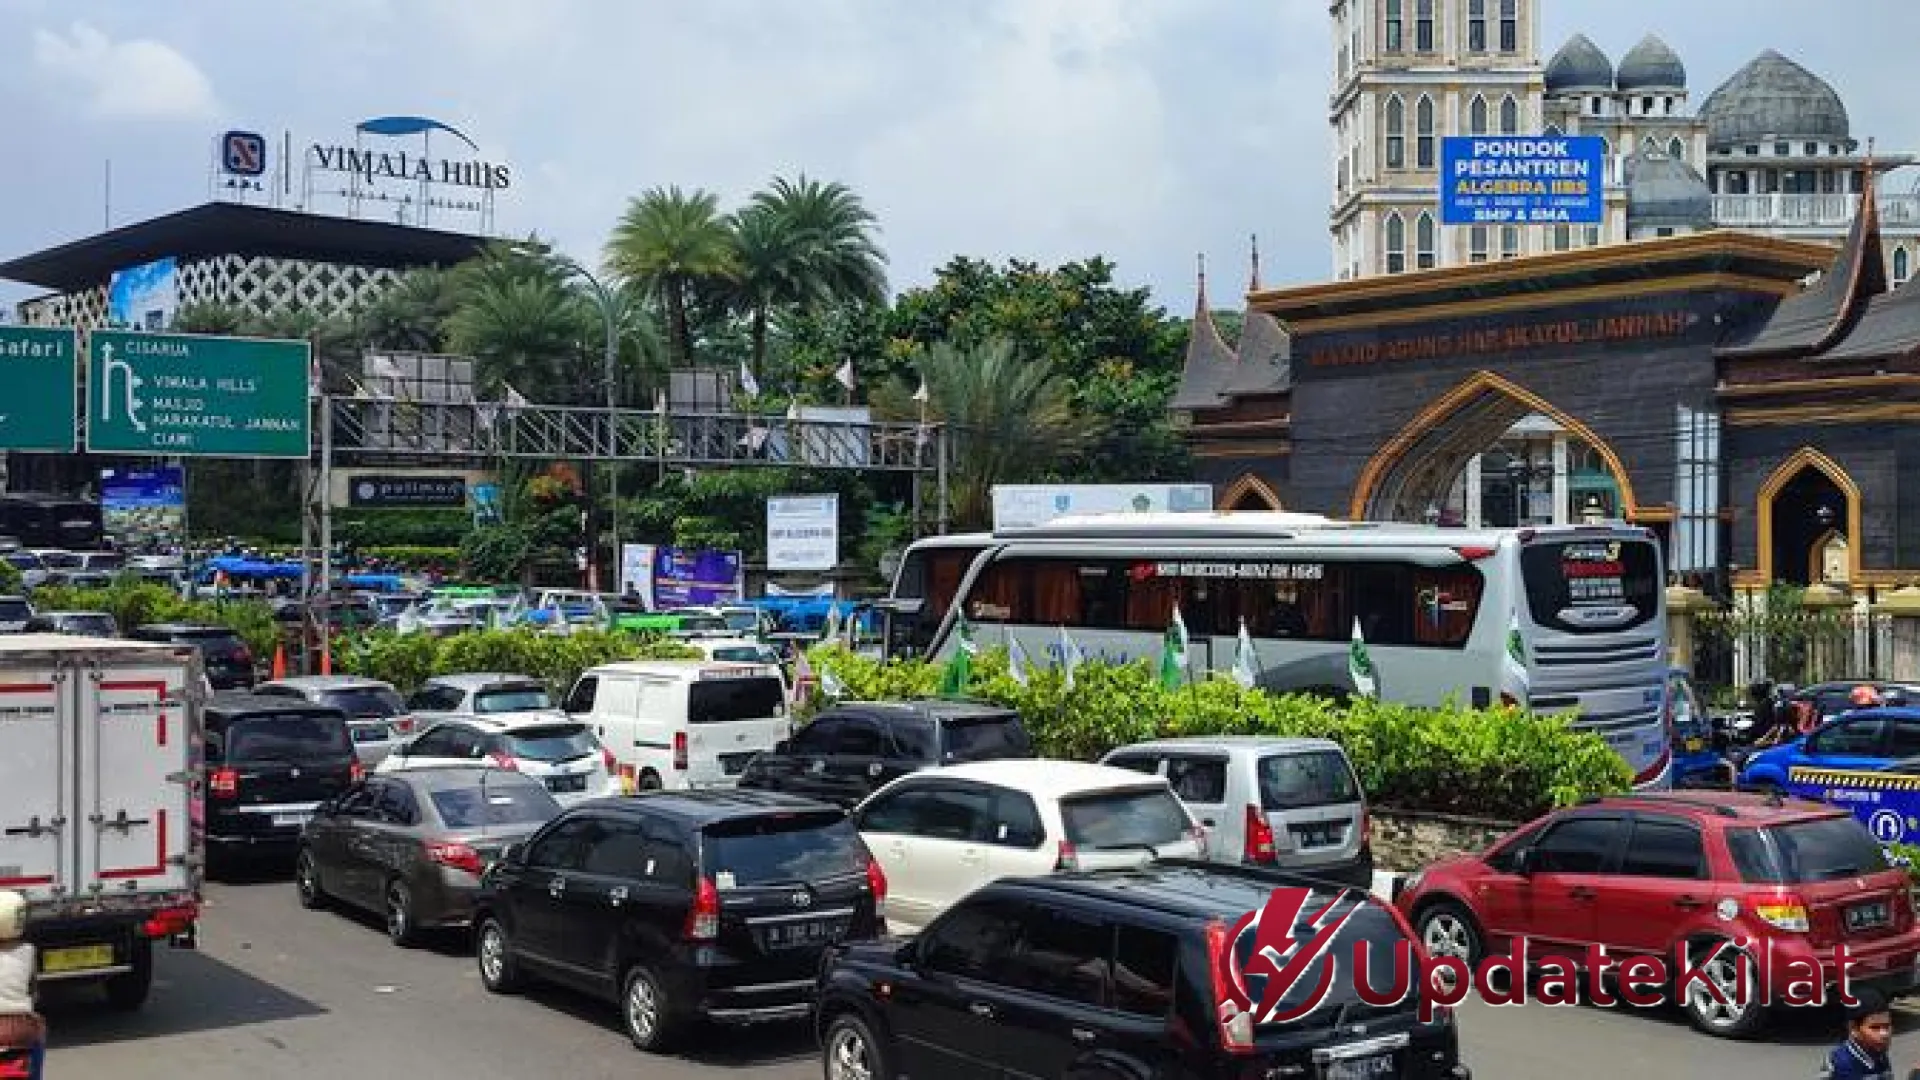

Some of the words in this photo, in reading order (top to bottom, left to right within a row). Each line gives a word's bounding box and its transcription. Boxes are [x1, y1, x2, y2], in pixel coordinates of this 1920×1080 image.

[1475, 140, 1569, 157] PONDOK
[313, 143, 433, 184] VIMALA
[1455, 159, 1589, 176] PESANTREN
[1458, 180, 1546, 194] ALGEBRA
[1474, 208, 1512, 220] SMP
[1531, 208, 1569, 220] SMA
[125, 341, 189, 356] CISARUA
[153, 375, 208, 390] VIMALA
[216, 378, 257, 392] HILLS
[153, 398, 204, 411] MASJID
